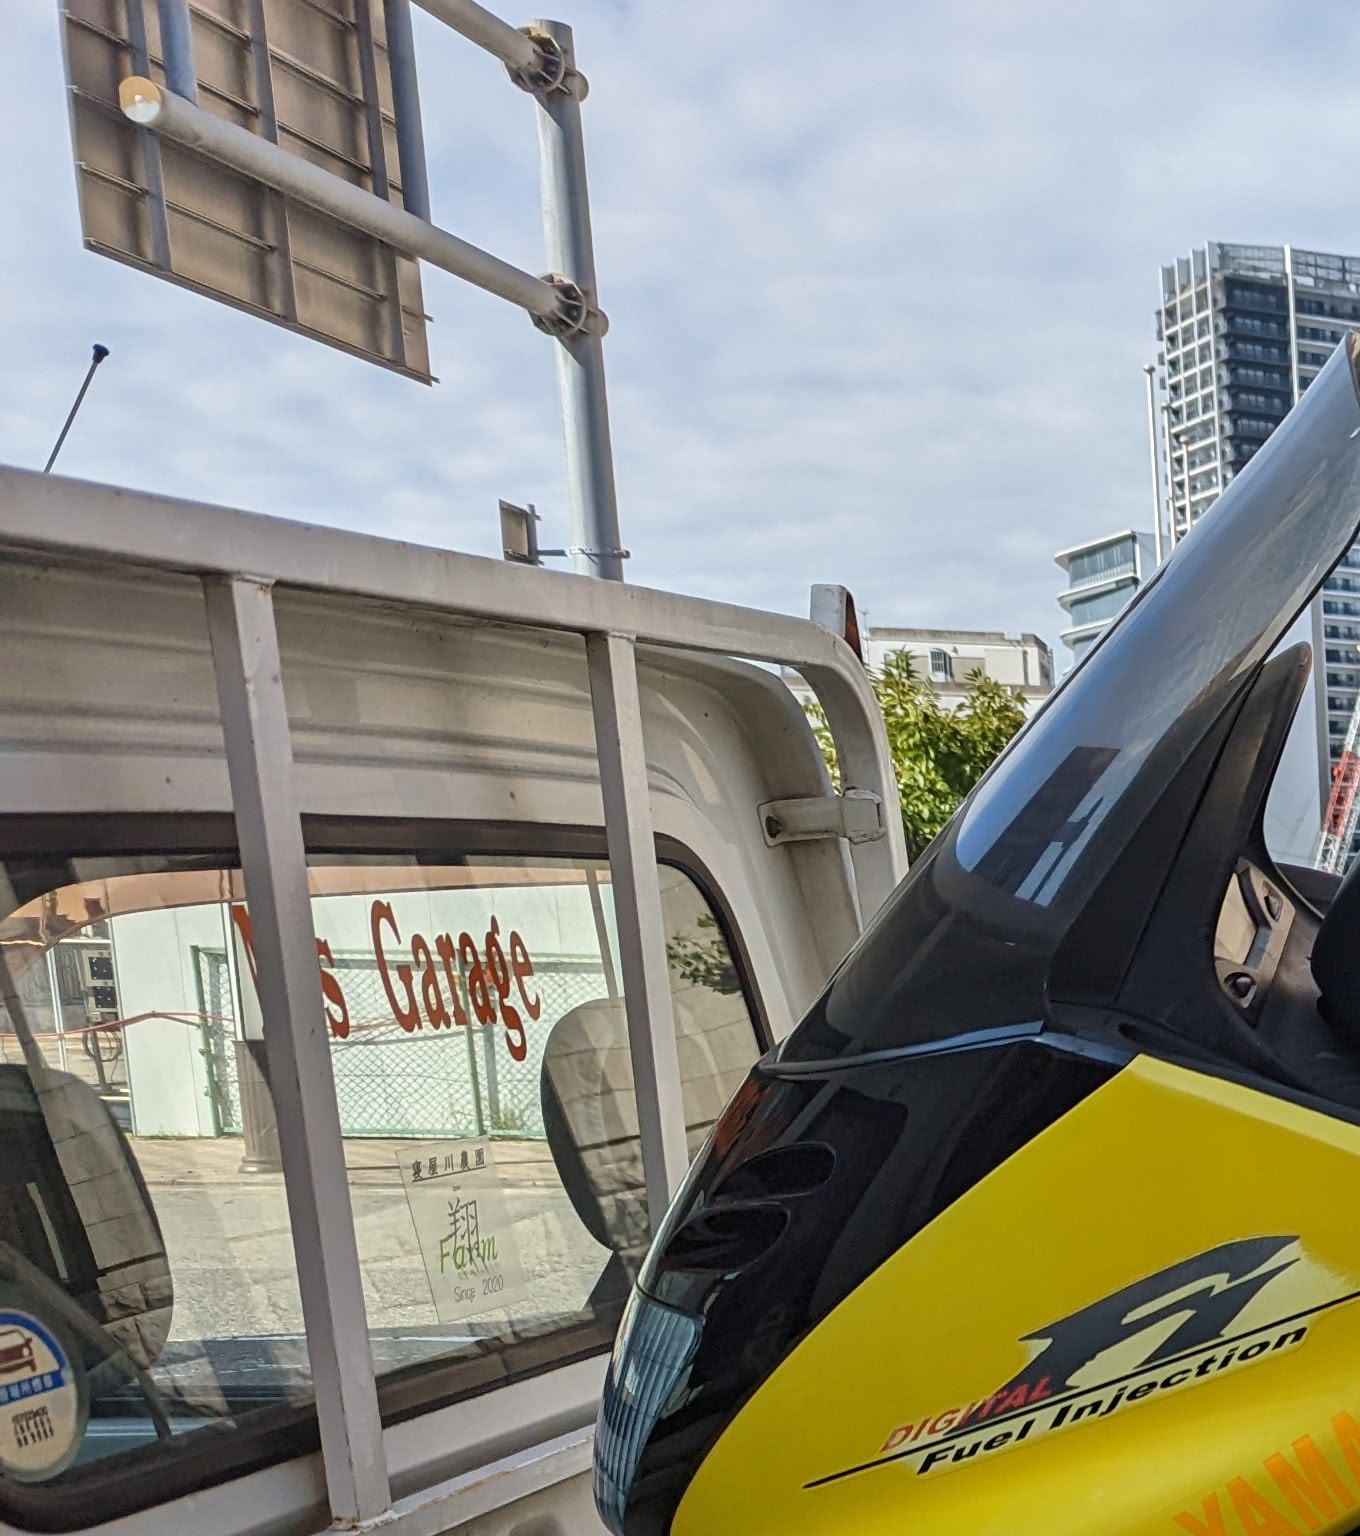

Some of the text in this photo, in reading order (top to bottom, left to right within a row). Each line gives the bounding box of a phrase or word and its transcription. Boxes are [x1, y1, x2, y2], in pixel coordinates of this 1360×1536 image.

[371, 900, 541, 1062] Garage
[438, 1235, 499, 1275] Farm
[454, 1274, 504, 1303] Since 2020
[879, 1376, 1053, 1452] DIGITAL
[916, 1326, 1309, 1476] Fuel Injection
